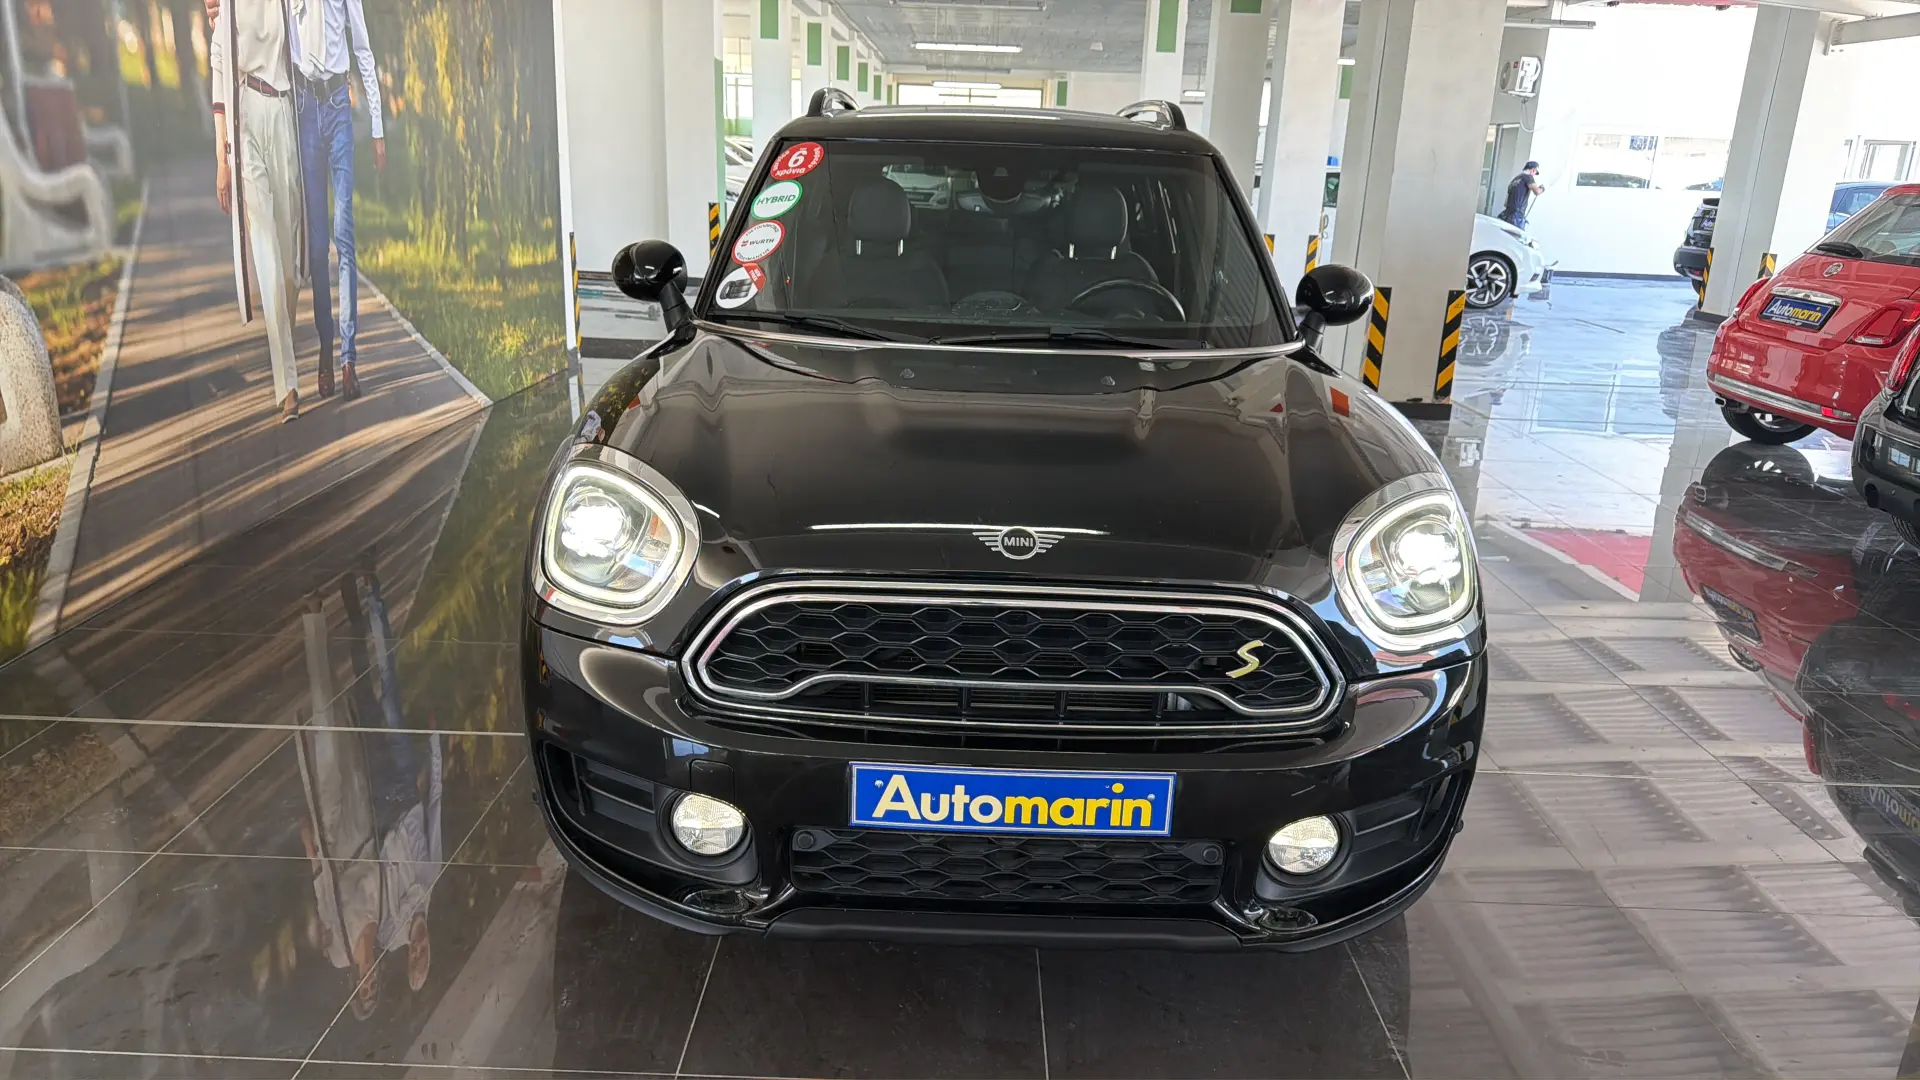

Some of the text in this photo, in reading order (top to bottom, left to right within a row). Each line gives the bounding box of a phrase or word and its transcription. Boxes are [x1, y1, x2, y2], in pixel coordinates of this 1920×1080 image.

[787, 150, 808, 168] 6
[756, 194, 797, 205] HYBRID
[1766, 299, 1822, 322] Automarin
[1003, 536, 1034, 547] MINI
[1225, 639, 1264, 679] S
[872, 774, 1152, 827] Automarin
